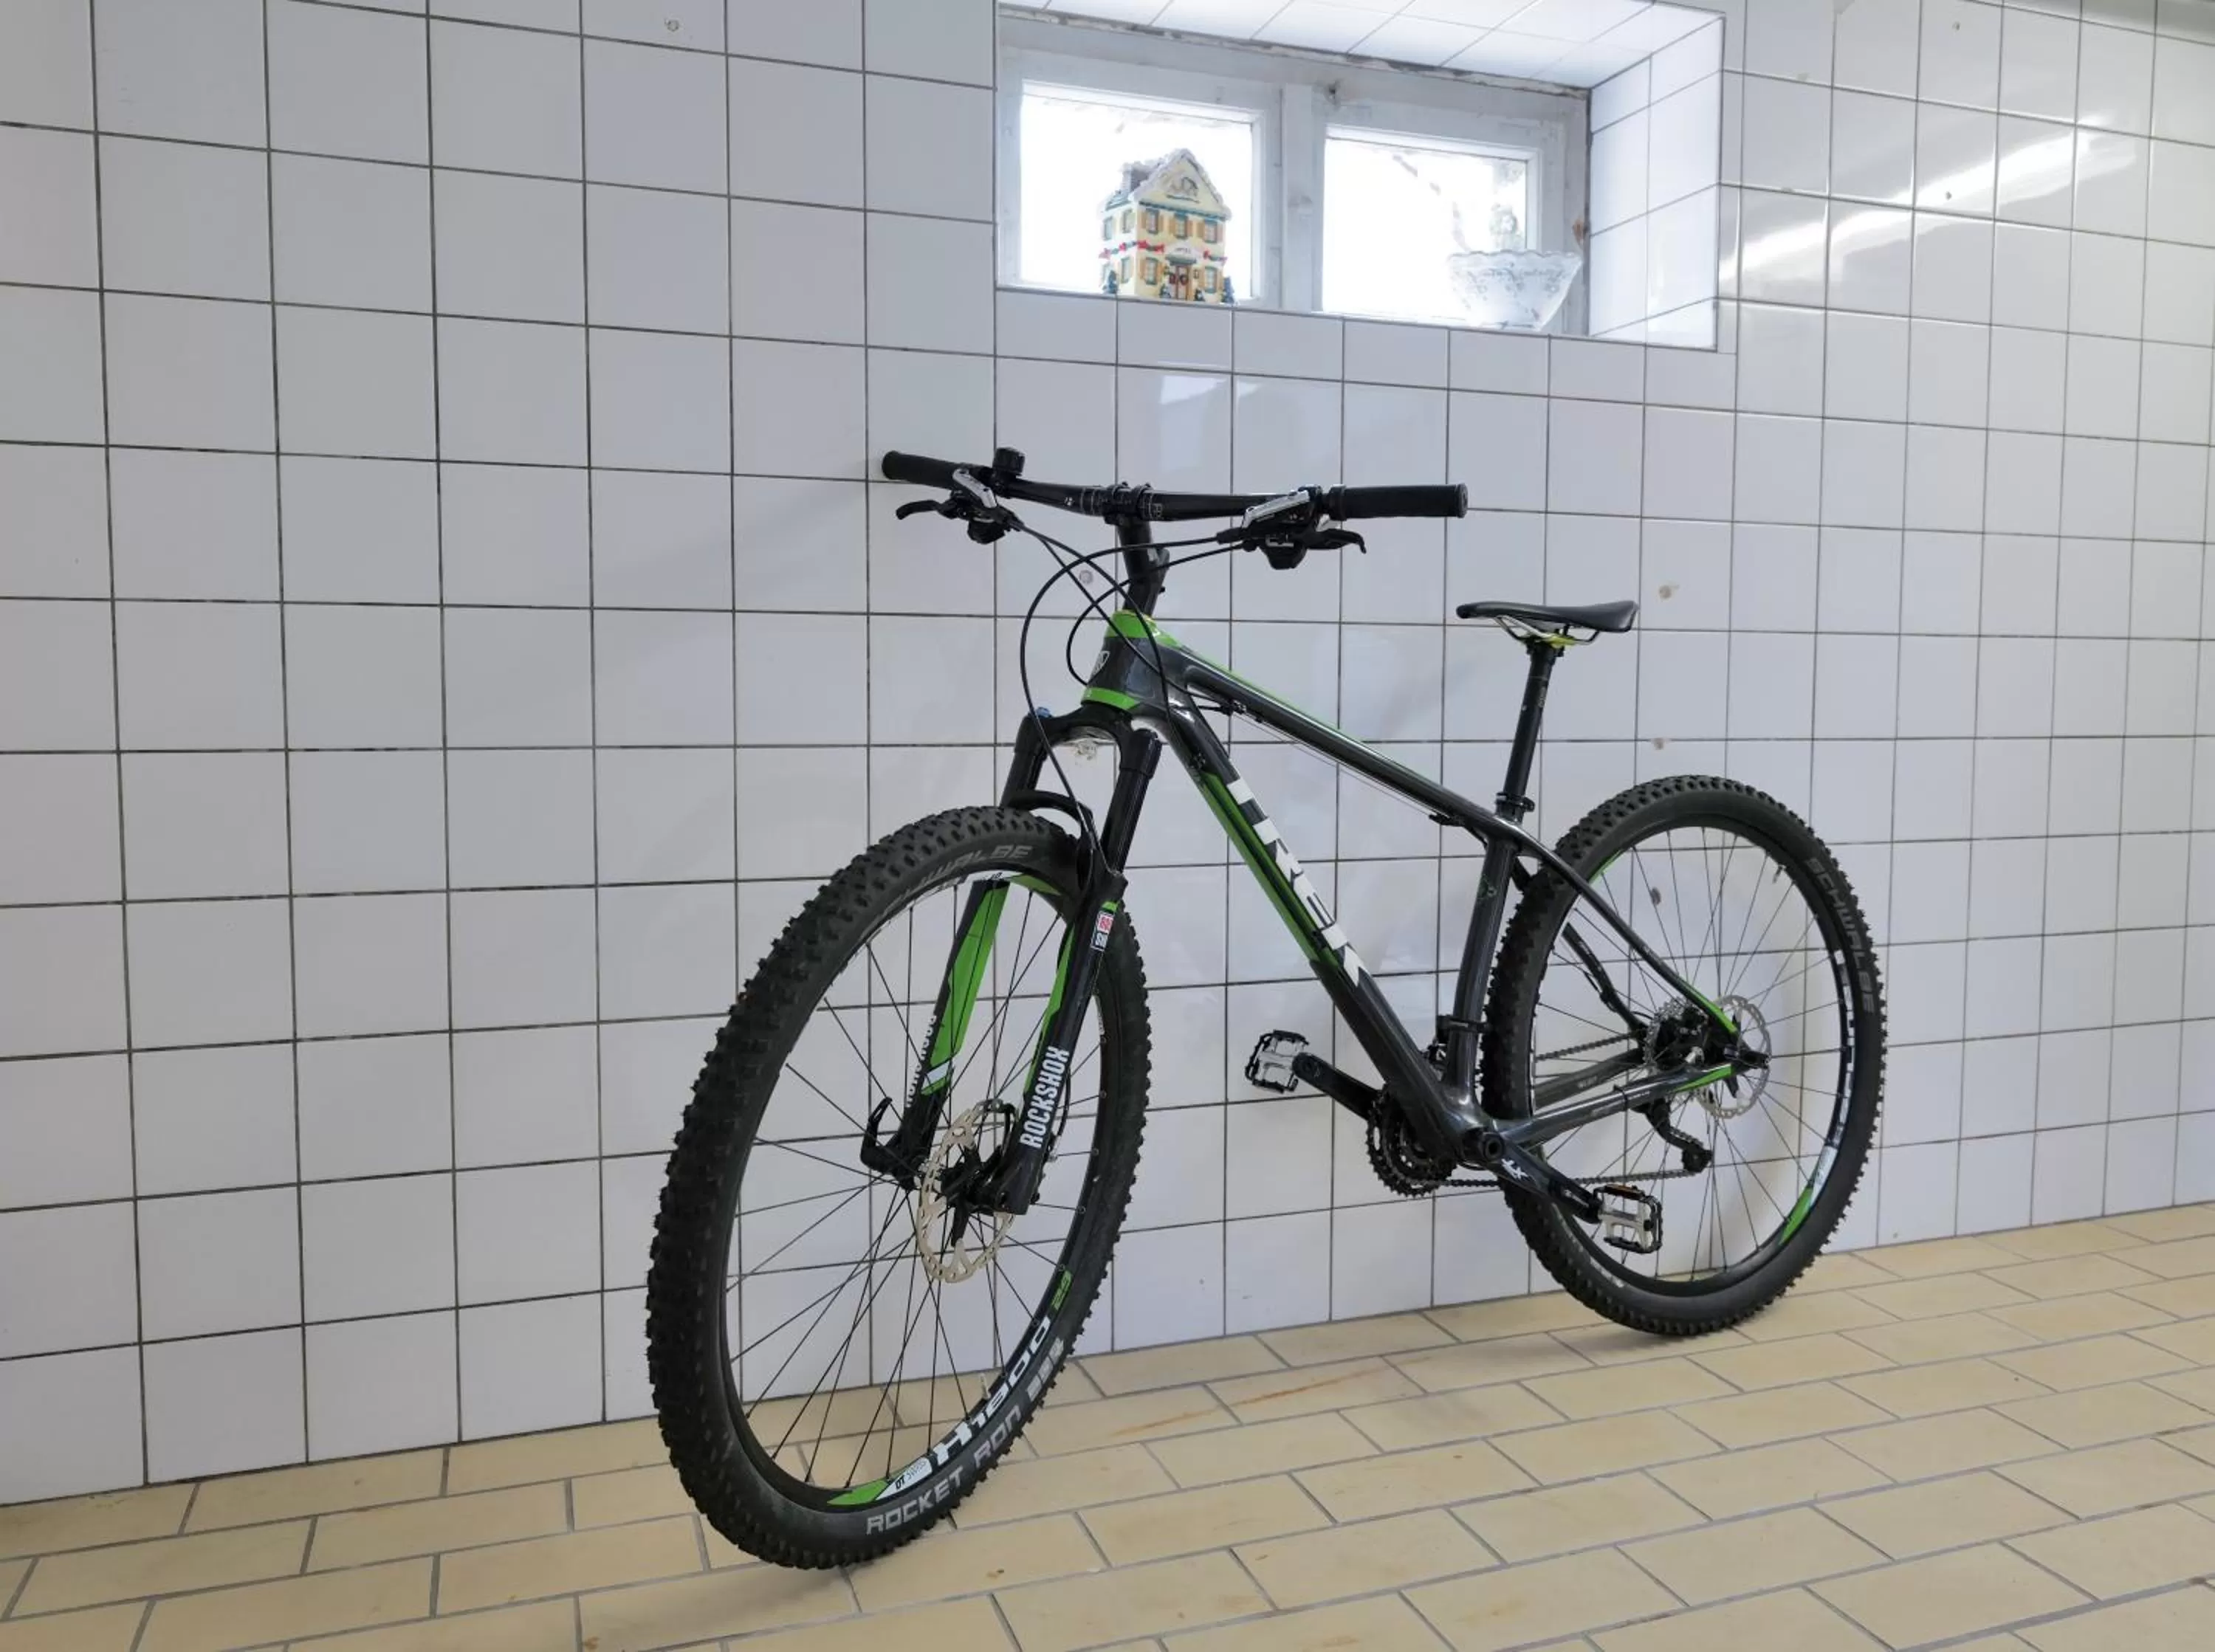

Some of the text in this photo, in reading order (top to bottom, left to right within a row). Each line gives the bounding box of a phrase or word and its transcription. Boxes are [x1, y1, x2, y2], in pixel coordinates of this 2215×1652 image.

[1226, 777, 1372, 988] TREK
[1807, 858, 1875, 1014] SCHWALBE
[1020, 1045, 1070, 1149] ROCKSHOX
[866, 1405, 1022, 1535] ROCKET RON
